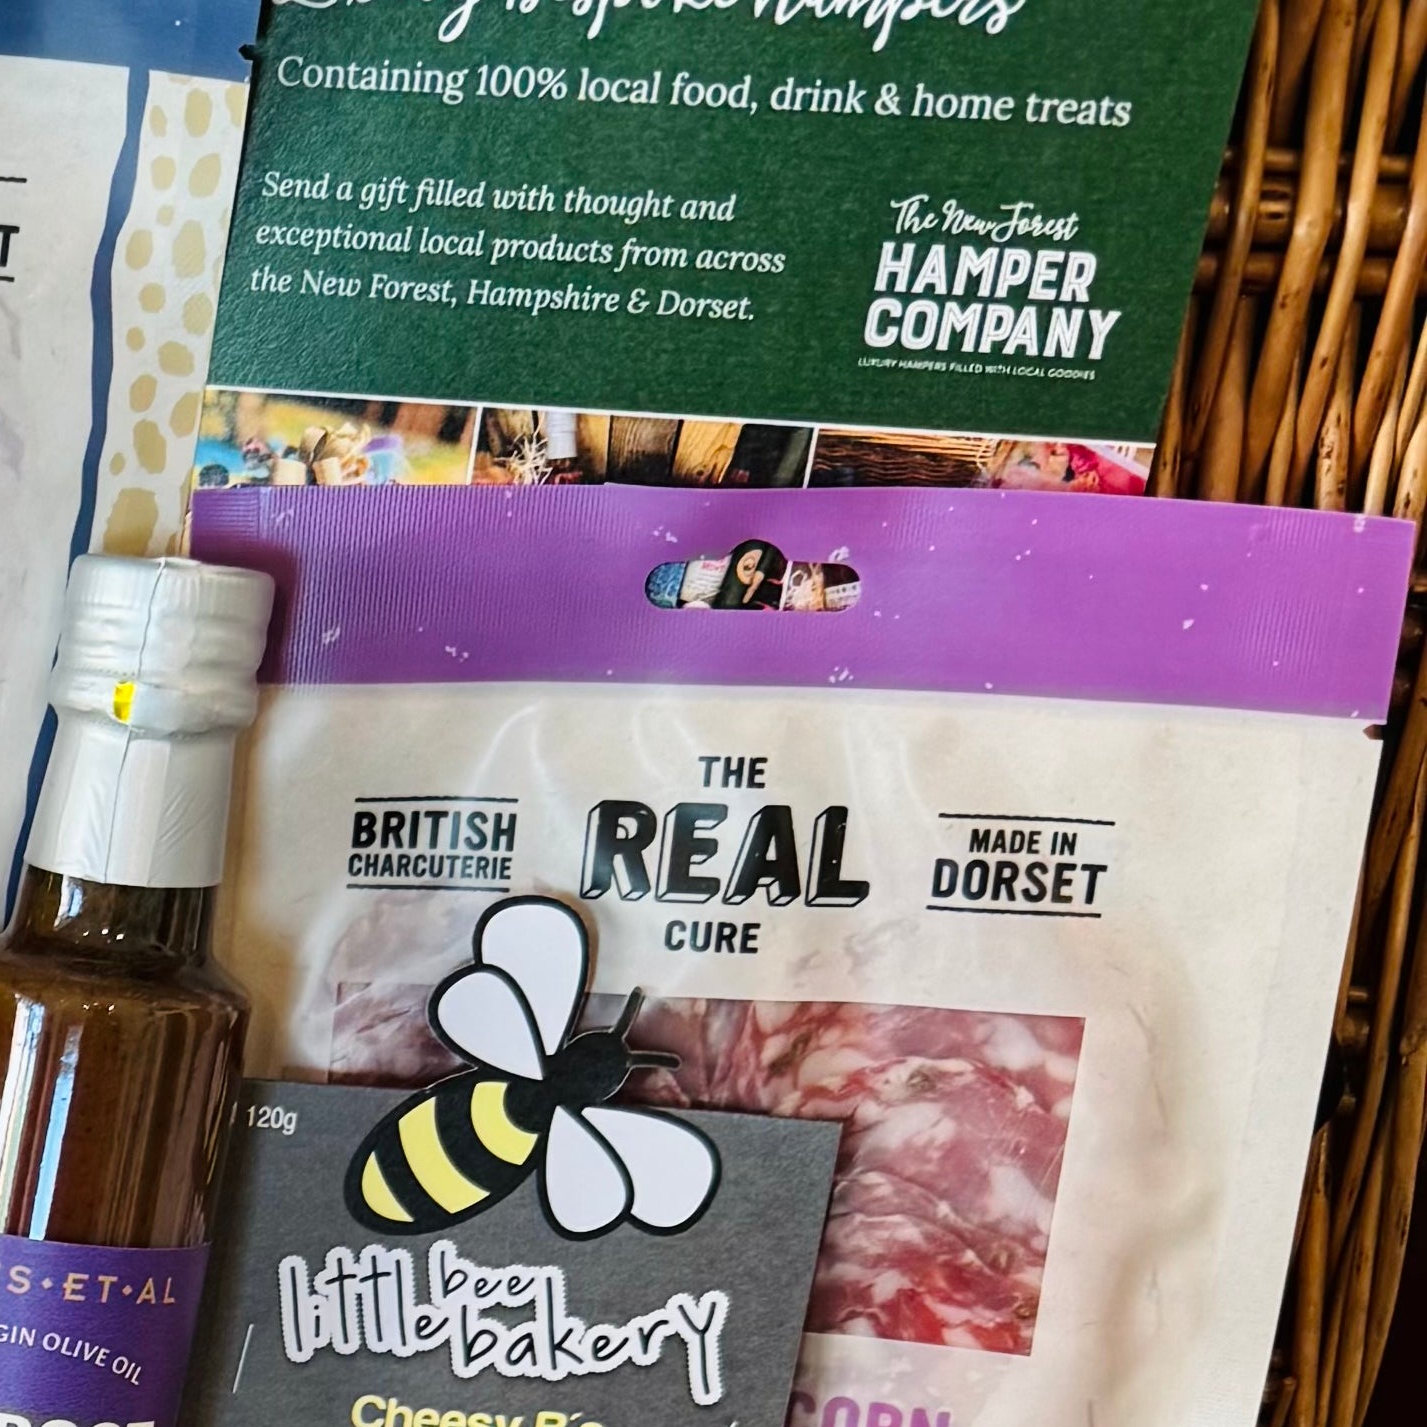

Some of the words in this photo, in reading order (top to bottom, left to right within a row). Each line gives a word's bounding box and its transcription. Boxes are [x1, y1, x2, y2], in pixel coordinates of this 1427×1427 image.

[277, 56, 468, 104] Containing
[476, 65, 568, 100] 100%
[578, 68, 659, 104] local
[670, 73, 758, 115] food,
[770, 80, 865, 115] drink
[874, 84, 902, 115] &
[912, 83, 1014, 121] home
[1025, 95, 1132, 128] treats
[262, 173, 330, 199] Send
[336, 182, 352, 201] a
[359, 177, 409, 210] gift
[409, 178, 484, 212] filled
[493, 185, 555, 212] with
[564, 188, 674, 224] thought
[680, 195, 735, 223] and
[256, 224, 410, 256] exceptional
[419, 229, 484, 257] local
[492, 234, 612, 265] products
[615, 238, 687, 272] from
[696, 247, 785, 274] across
[874, 241, 1097, 302] HAMPER
[250, 267, 292, 294] the
[302, 271, 362, 296] New
[370, 274, 457, 305] Forest,
[468, 280, 619, 315] Hampshire
[627, 288, 650, 313] &
[657, 290, 755, 321] Dorset.
[864, 299, 1122, 361] COMPANY
[698, 756, 767, 788] THE
[351, 811, 517, 852] BRITISH
[580, 799, 870, 908] REAL
[969, 828, 1042, 855] MADE
[1050, 830, 1076, 855] IN
[347, 852, 512, 882] CHARCUTERIE
[931, 859, 1107, 905] DORSET
[664, 920, 760, 954] CURE
[246, 1105, 298, 1135] 120g
[288, 1255, 447, 1354] little
[440, 1250, 535, 1298] bee
[43, 1332, 110, 1367] OLIVE
[112, 1356, 143, 1385] OIL
[463, 1276, 718, 1396] bakery
